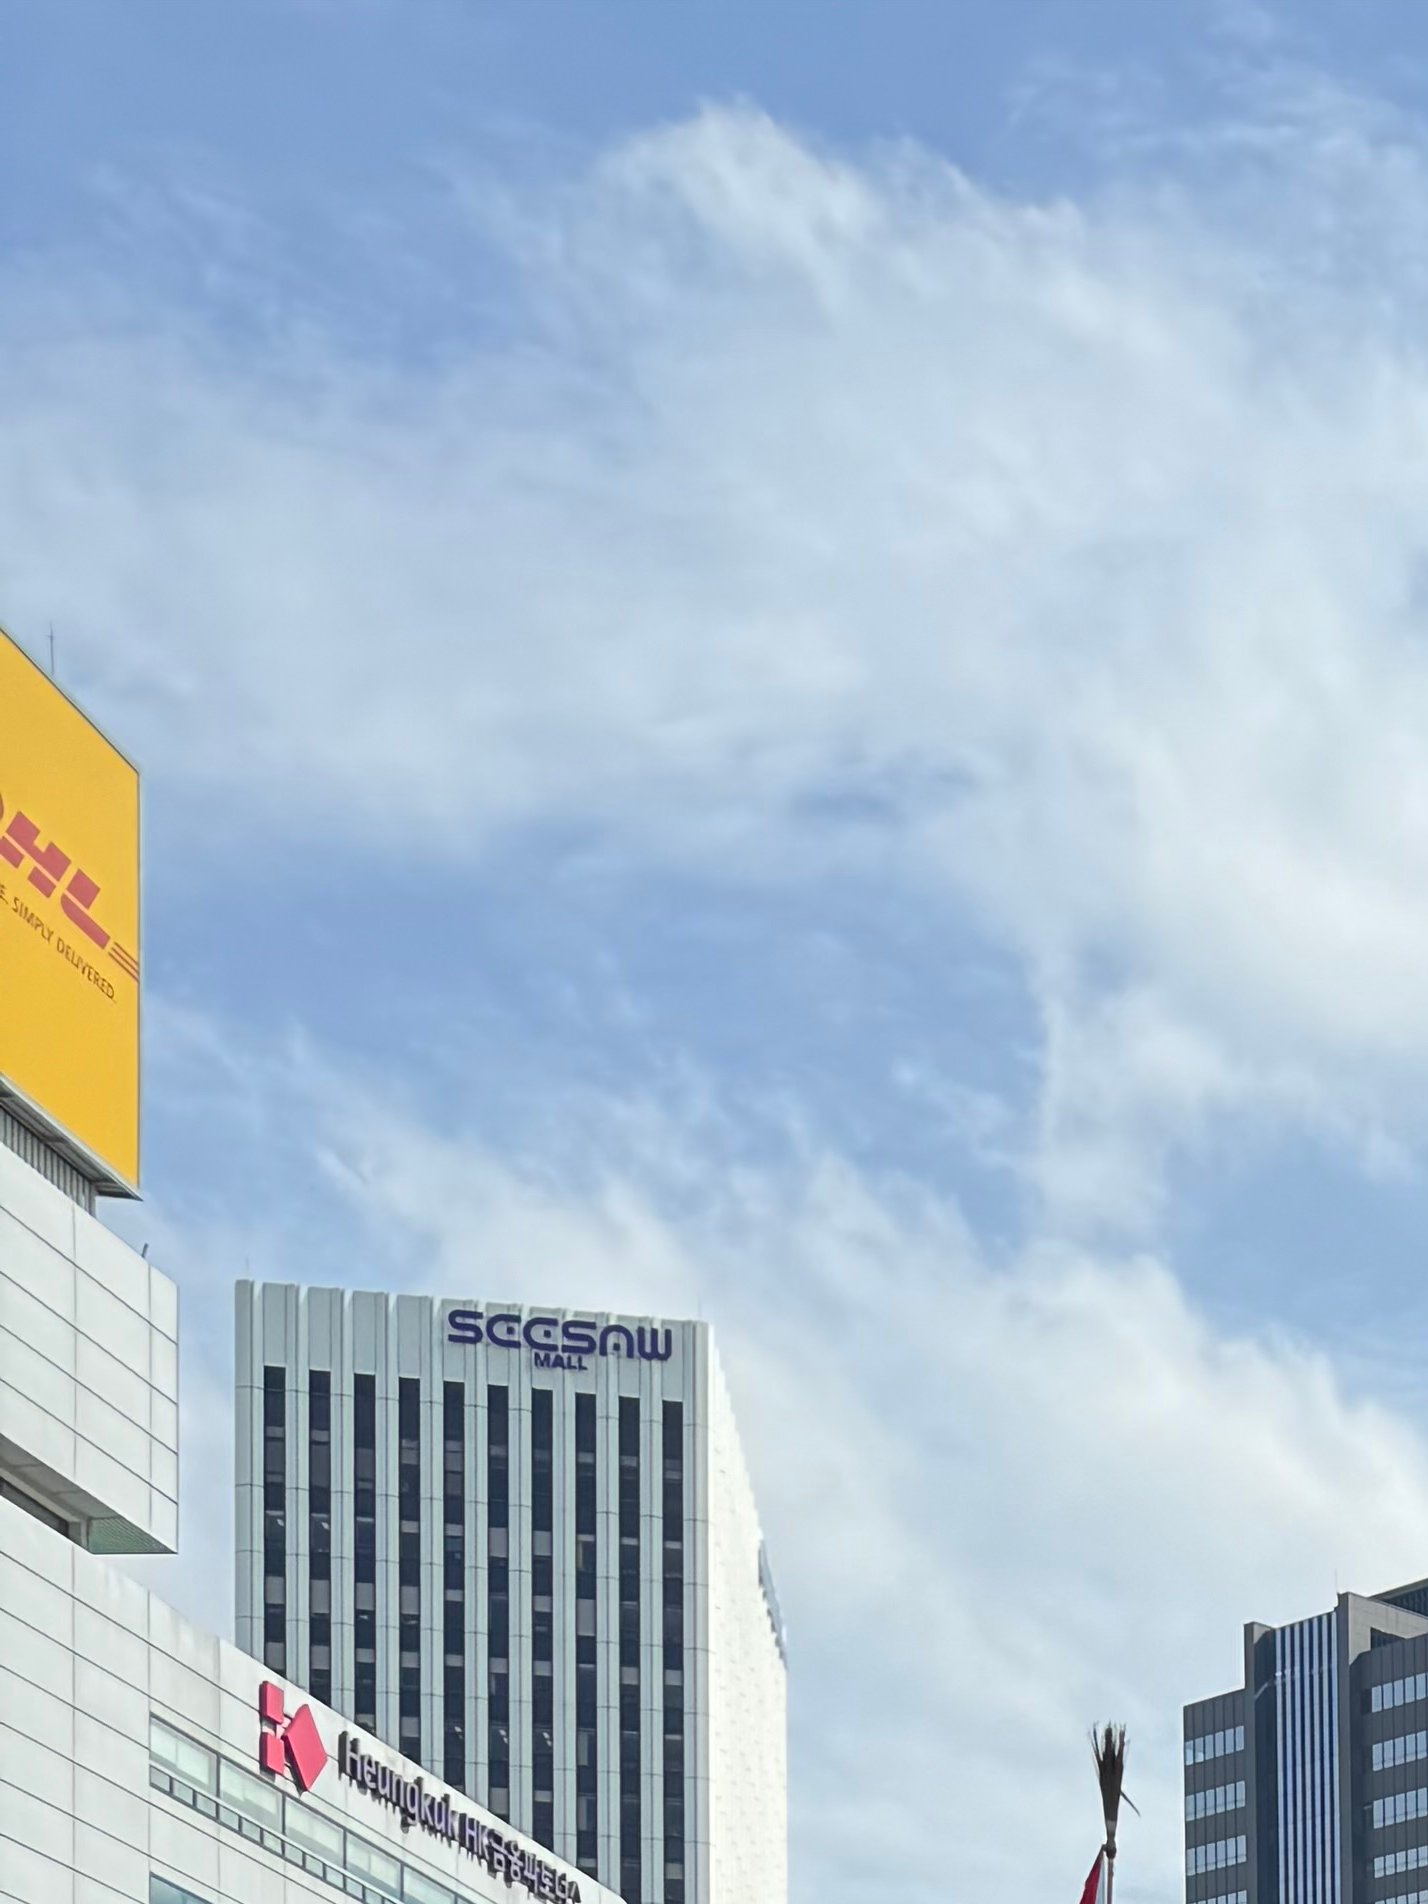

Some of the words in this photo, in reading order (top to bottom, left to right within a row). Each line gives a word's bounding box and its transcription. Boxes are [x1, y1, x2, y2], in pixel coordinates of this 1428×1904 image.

[0, 790, 111, 950] HL
[12, 897, 54, 943] SIMPLY
[448, 1309, 672, 1361] SEESAW
[534, 1352, 588, 1371] MALL
[338, 1731, 460, 1848] Heungkuk
